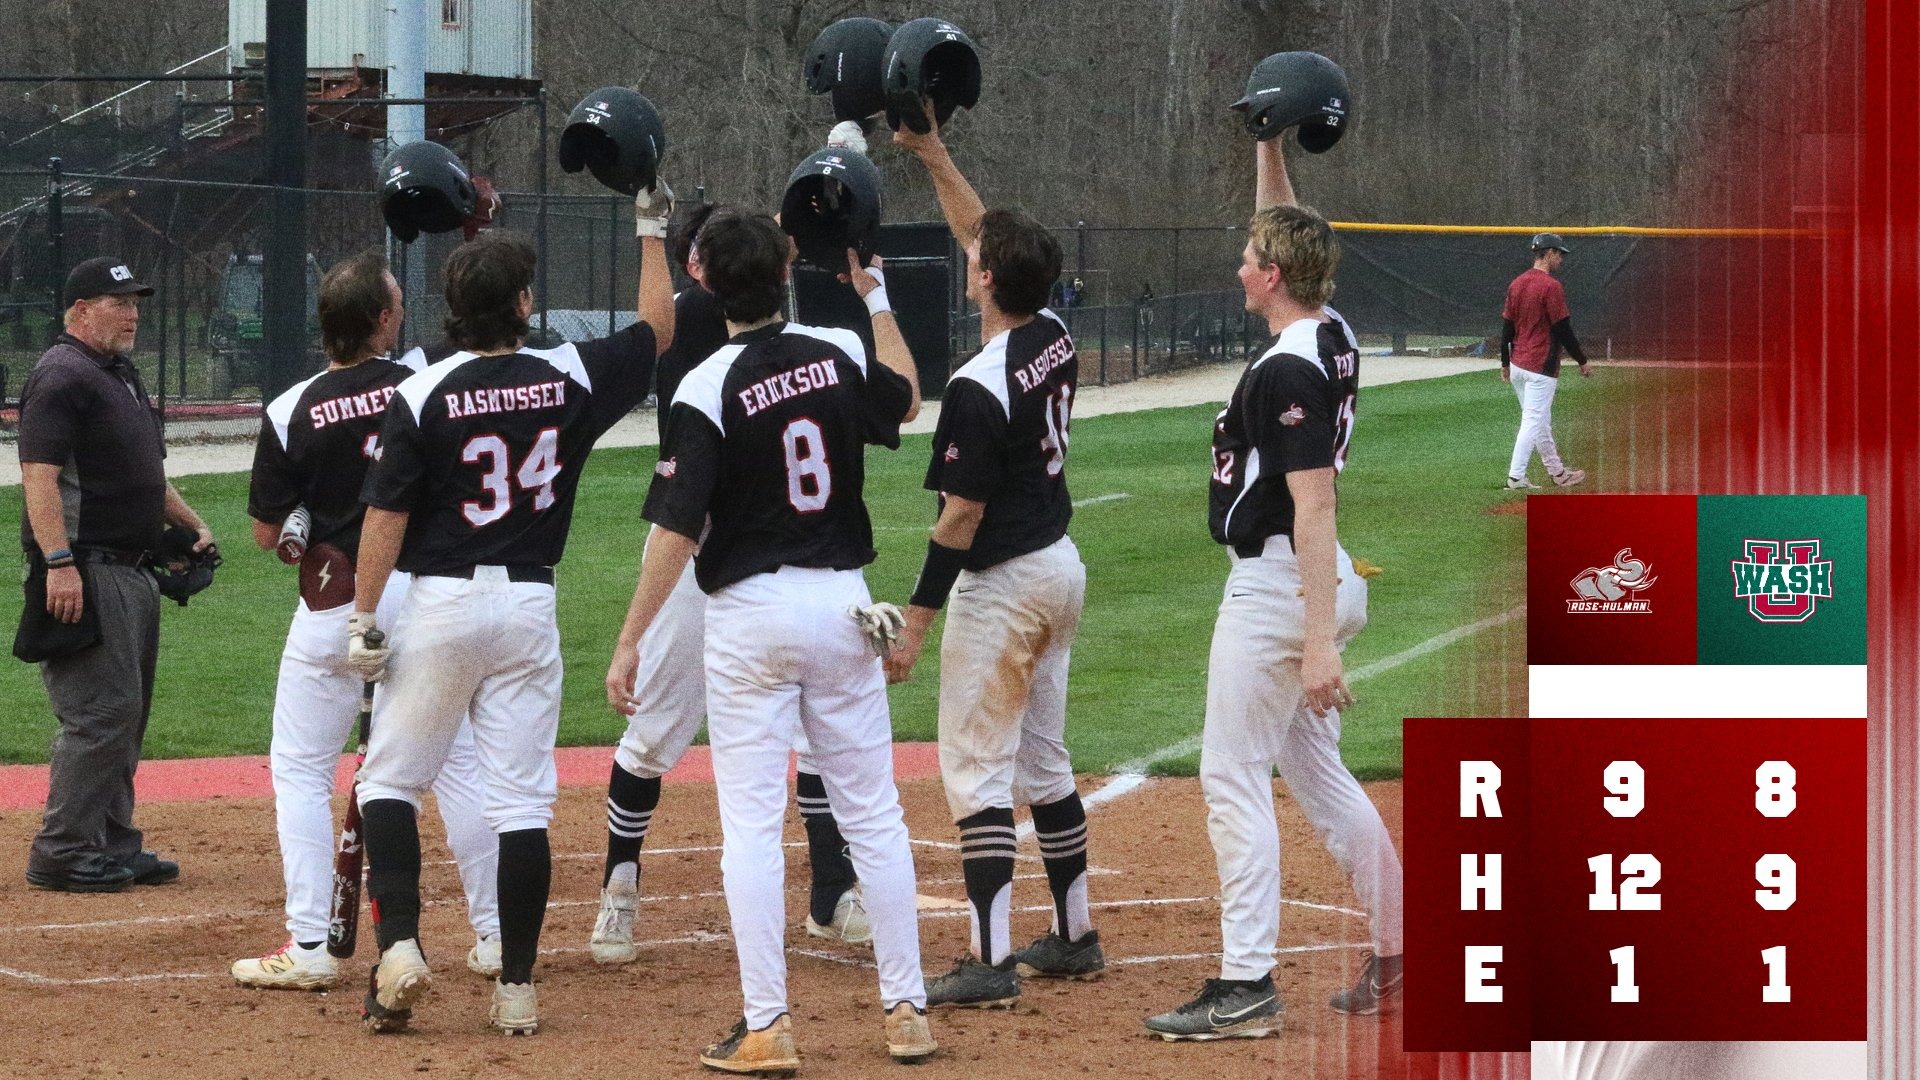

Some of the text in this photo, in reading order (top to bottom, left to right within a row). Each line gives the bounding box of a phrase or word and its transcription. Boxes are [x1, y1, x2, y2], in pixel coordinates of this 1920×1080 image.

[586, 113, 601, 125] 34
[1326, 115, 1339, 126] 32
[823, 166, 832, 175] 8
[445, 381, 566, 419] RASMUSSEN
[738, 359, 840, 417] ERICKSON
[460, 427, 562, 527] 34
[782, 416, 832, 514] 8
